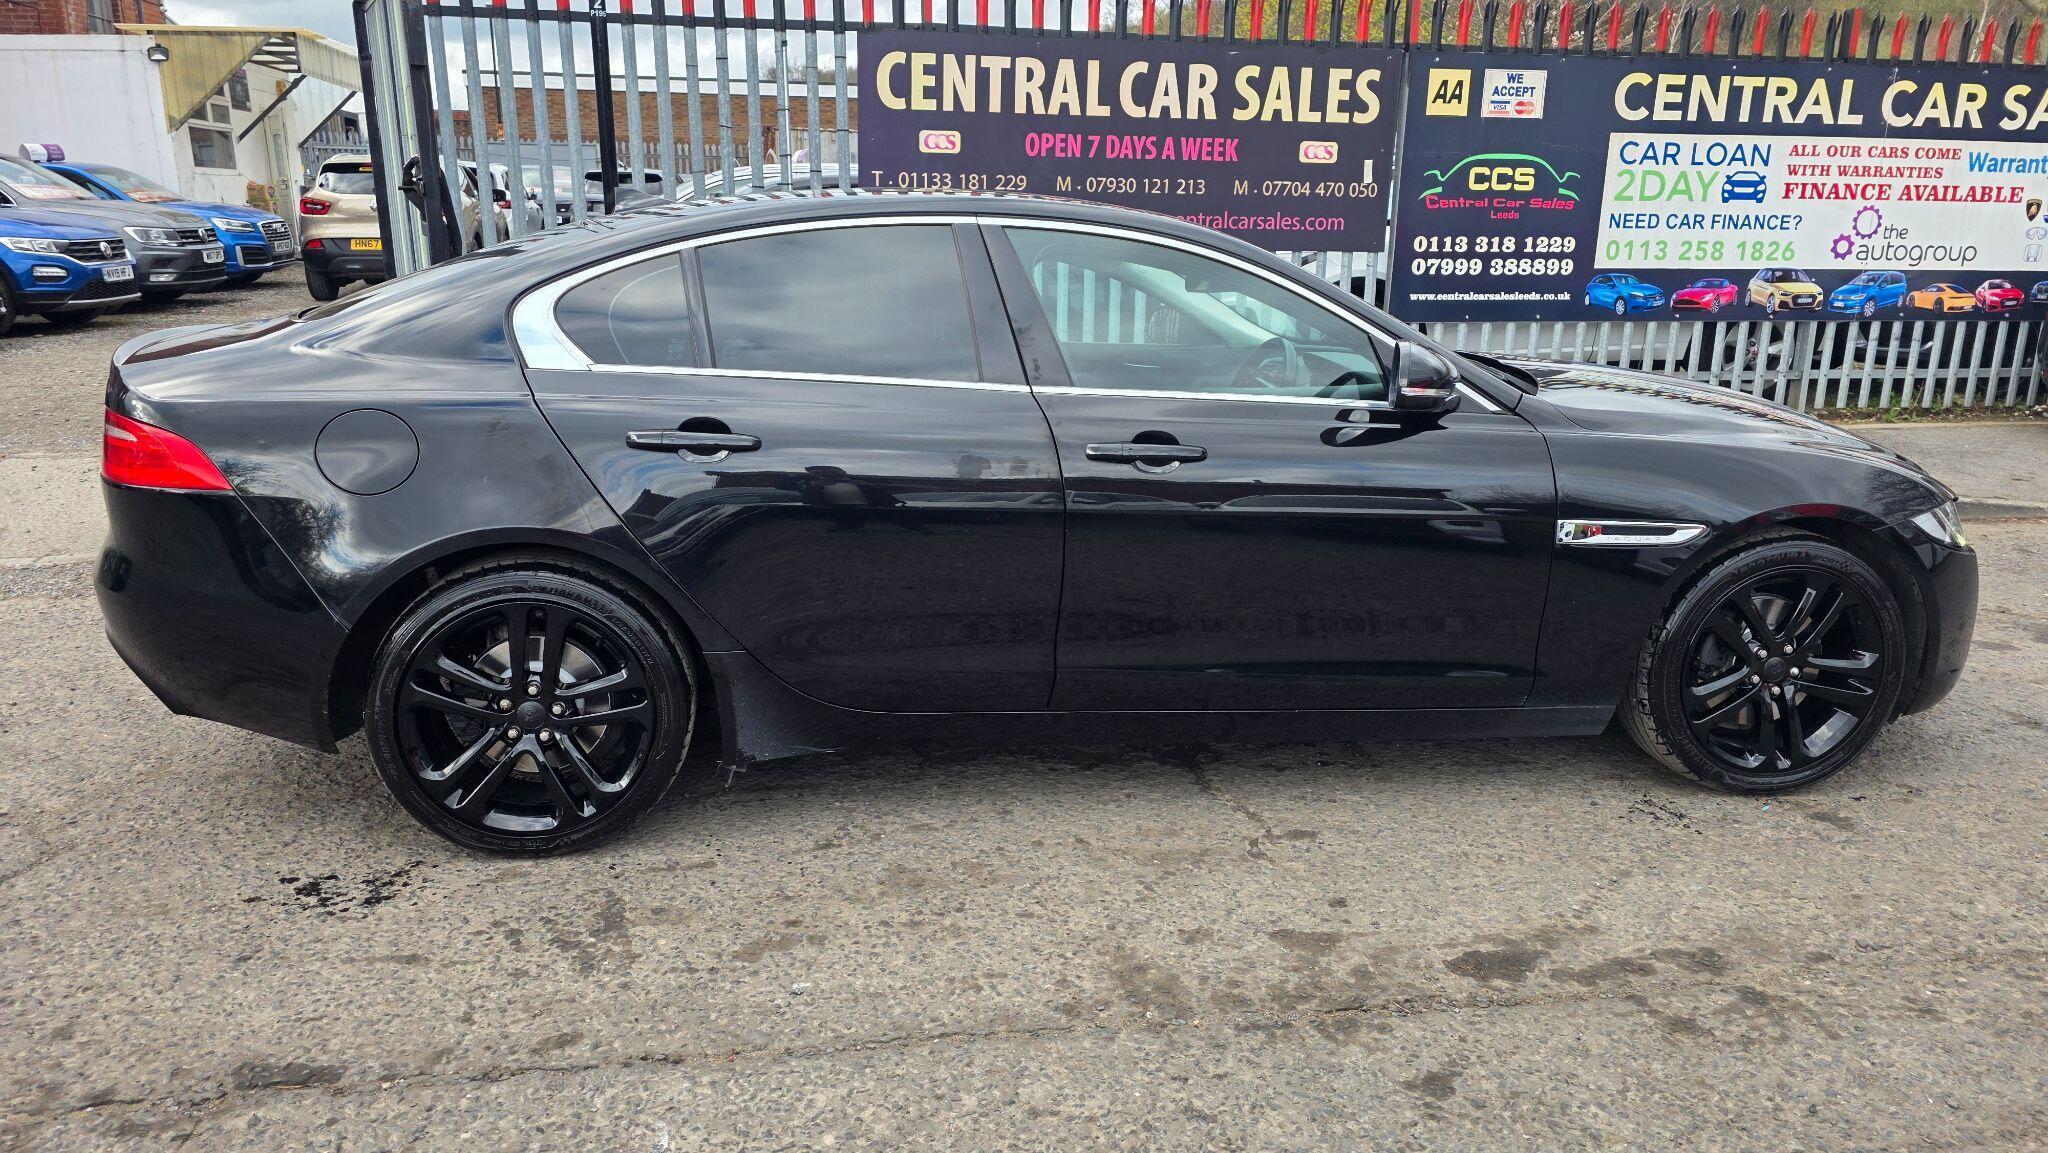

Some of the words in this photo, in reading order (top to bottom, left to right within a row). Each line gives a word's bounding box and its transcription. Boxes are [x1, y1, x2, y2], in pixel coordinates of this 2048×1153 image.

[877, 51, 1110, 117] CENTRAL
[1119, 61, 1217, 120] CAR
[1233, 65, 1381, 124] SALES
[1507, 72, 1524, 84] WE
[1432, 79, 1463, 104] AA
[1492, 86, 1536, 97] ACCEPT
[1614, 72, 1863, 125] CENTRAL
[1881, 80, 1988, 129] CAR
[1026, 132, 1082, 159] OPEN
[1088, 136, 1102, 159] 7
[1106, 136, 1156, 161] DAYS
[1162, 138, 1176, 161] A
[1180, 138, 1239, 162] WEEK
[1619, 140, 1682, 166] CAR
[1691, 142, 1772, 168] LOAN
[1788, 144, 1820, 158] ALL
[1826, 145, 1862, 159] OUR
[1867, 146, 1912, 160] CARS
[1914, 148, 1962, 161] COME
[1787, 164, 1831, 178] WITH
[1837, 166, 1944, 179] WARRANTIES
[1968, 152, 2048, 174] Warrant
[872, 170, 884, 186] T
[898, 172, 952, 189] 01133
[960, 174, 987, 190] 181
[994, 175, 1027, 190] 229
[1056, 176, 1072, 192] M
[1086, 176, 1139, 194] 07930
[1144, 178, 1173, 194] 121
[1176, 179, 1206, 196] 213
[1468, 166, 1535, 191] CCS
[1613, 169, 1720, 202] 2DAY
[1234, 180, 1248, 196] M
[1262, 180, 1311, 197] 07704
[1315, 182, 1344, 197] 470
[1349, 182, 1378, 198] 050
[1782, 183, 1892, 201] FINANCE
[1897, 184, 2024, 203] AVAILABLE
[1426, 195, 1488, 210] Central
[1493, 198, 1526, 210] Car
[1529, 198, 1575, 210] Sales
[1490, 210, 1520, 220] Leeds
[1609, 214, 1658, 230] NEED
[1666, 214, 1705, 230] CAR
[1711, 214, 1802, 231] FINANCE?
[1884, 224, 1908, 240] the
[354, 240, 379, 249] HN67
[1414, 236, 1468, 253] 0113
[1475, 236, 1516, 253] 318
[1524, 236, 1576, 252] 1229
[1606, 240, 1668, 261] 0113
[1678, 240, 1724, 262] 258
[1736, 240, 1796, 262] 1826
[1856, 243, 1978, 266] autogroup
[1412, 258, 1482, 276] 07999
[1490, 258, 1574, 276] 388899
[1410, 291, 1571, 302] www.centralcarsalesleeds.co.uk
